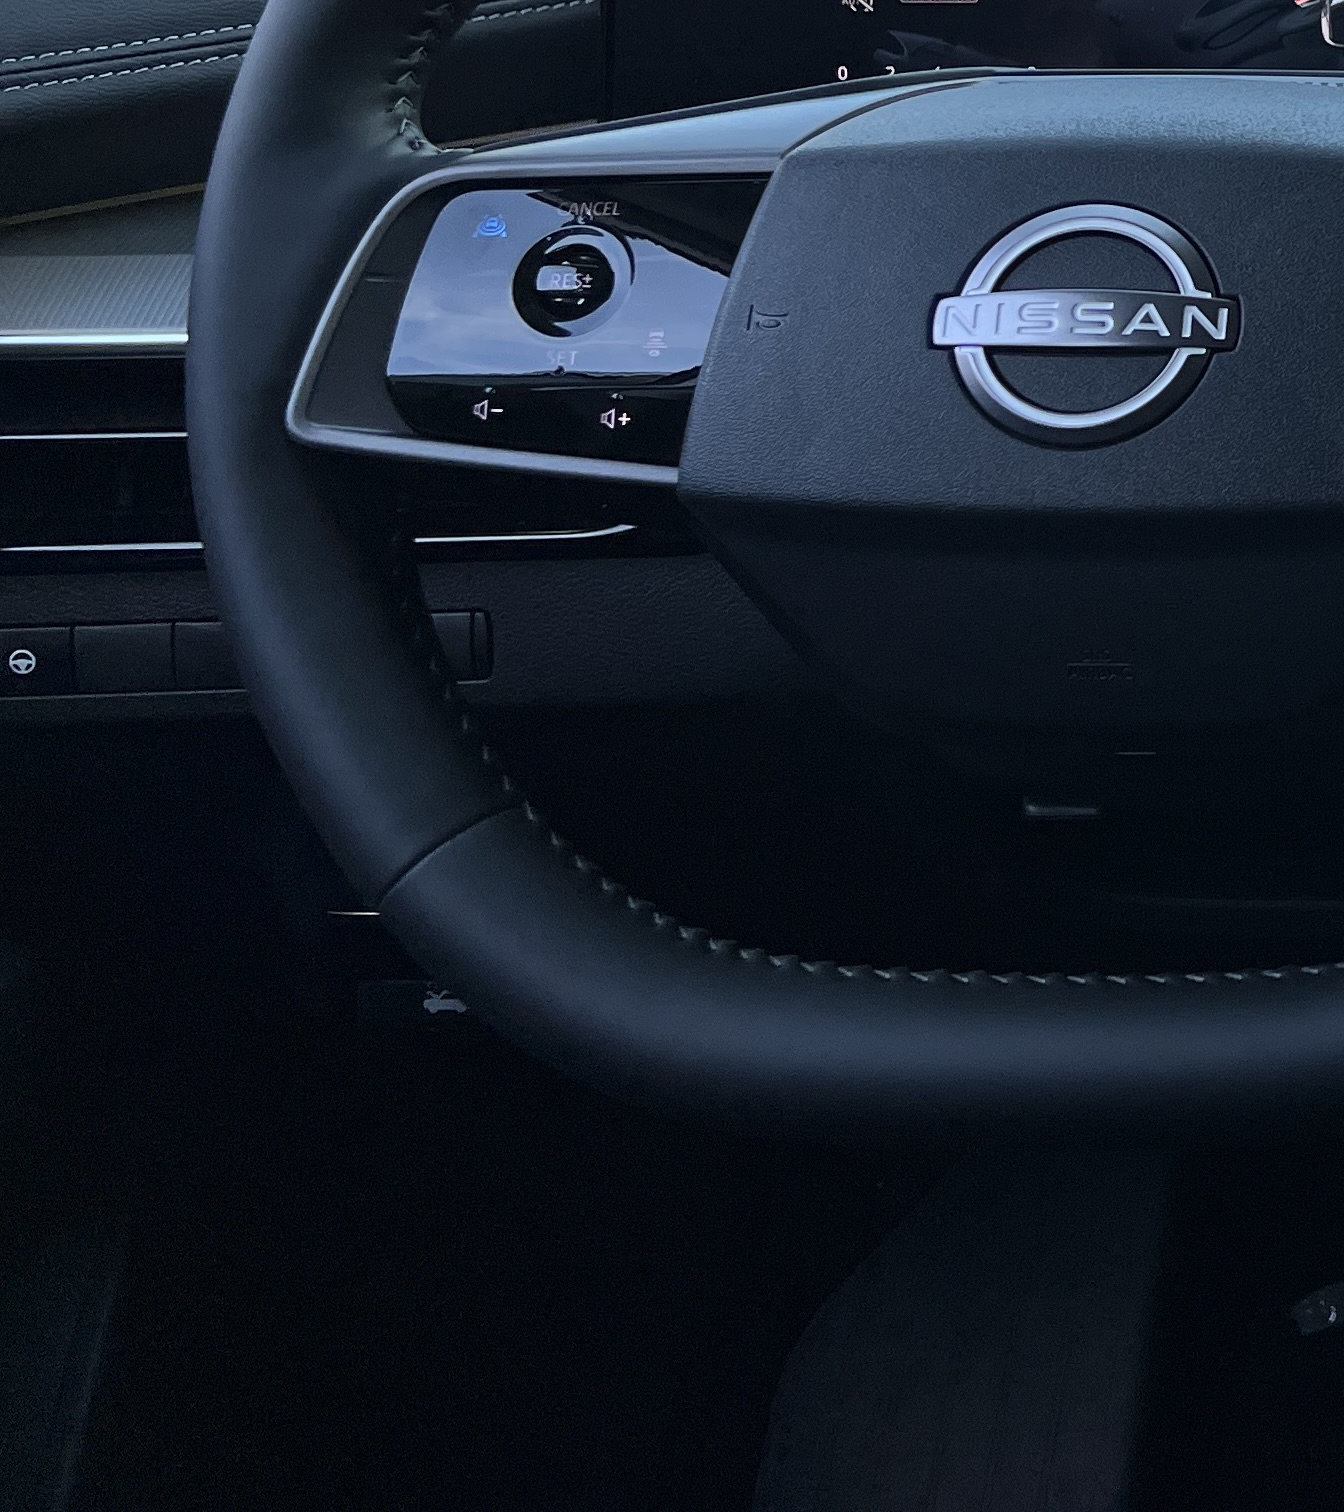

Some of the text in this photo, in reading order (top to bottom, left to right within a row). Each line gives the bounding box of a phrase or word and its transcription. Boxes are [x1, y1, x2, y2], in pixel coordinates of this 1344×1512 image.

[838, 65, 849, 82] 0
[558, 201, 621, 218] CANCEL
[942, 301, 1229, 341] NISSAN
[545, 350, 580, 366] SET
